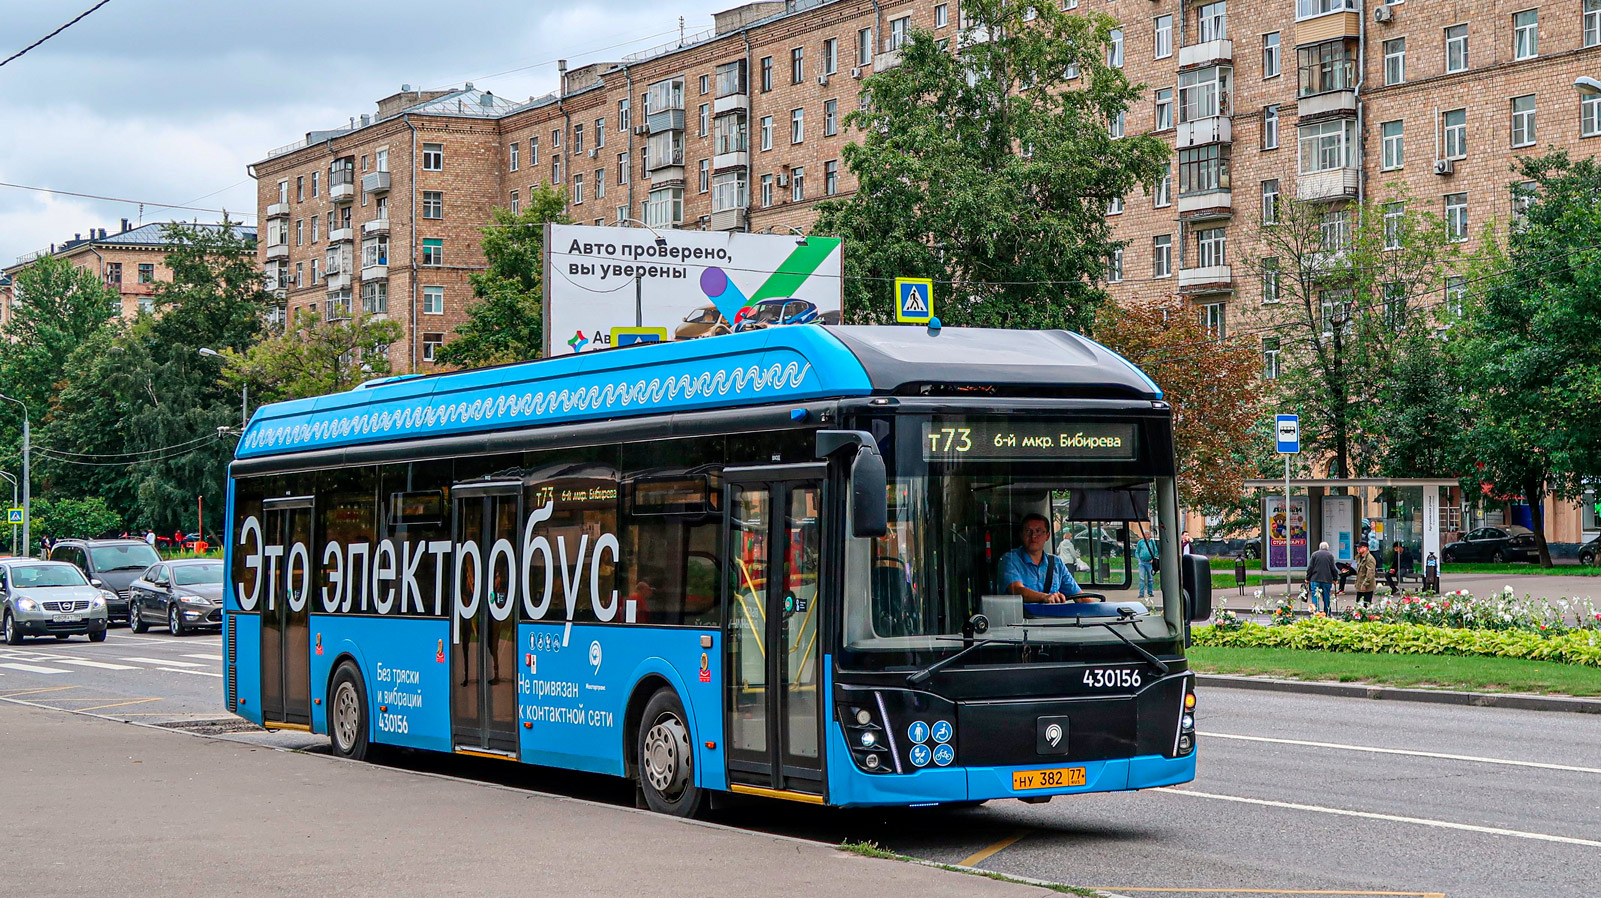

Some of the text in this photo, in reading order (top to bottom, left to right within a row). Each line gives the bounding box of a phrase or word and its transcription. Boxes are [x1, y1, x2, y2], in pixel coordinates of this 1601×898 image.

[568, 239, 732, 263] Авто проверено,
[569, 263, 687, 280] вы уверены
[928, 428, 1121, 452] т73 6-й мкр. Бибирева
[238, 501, 637, 648] Это электробус.
[377, 662, 420, 687] Без тряски
[518, 672, 531, 694] Не
[532, 679, 579, 700] привязан
[1083, 669, 1142, 688] 430156
[377, 686, 422, 709] и вибраций
[379, 713, 409, 734] 430156
[518, 703, 613, 728] к контактной сети
[1040, 771, 1063, 786] 382
[1069, 769, 1082, 780] 77
